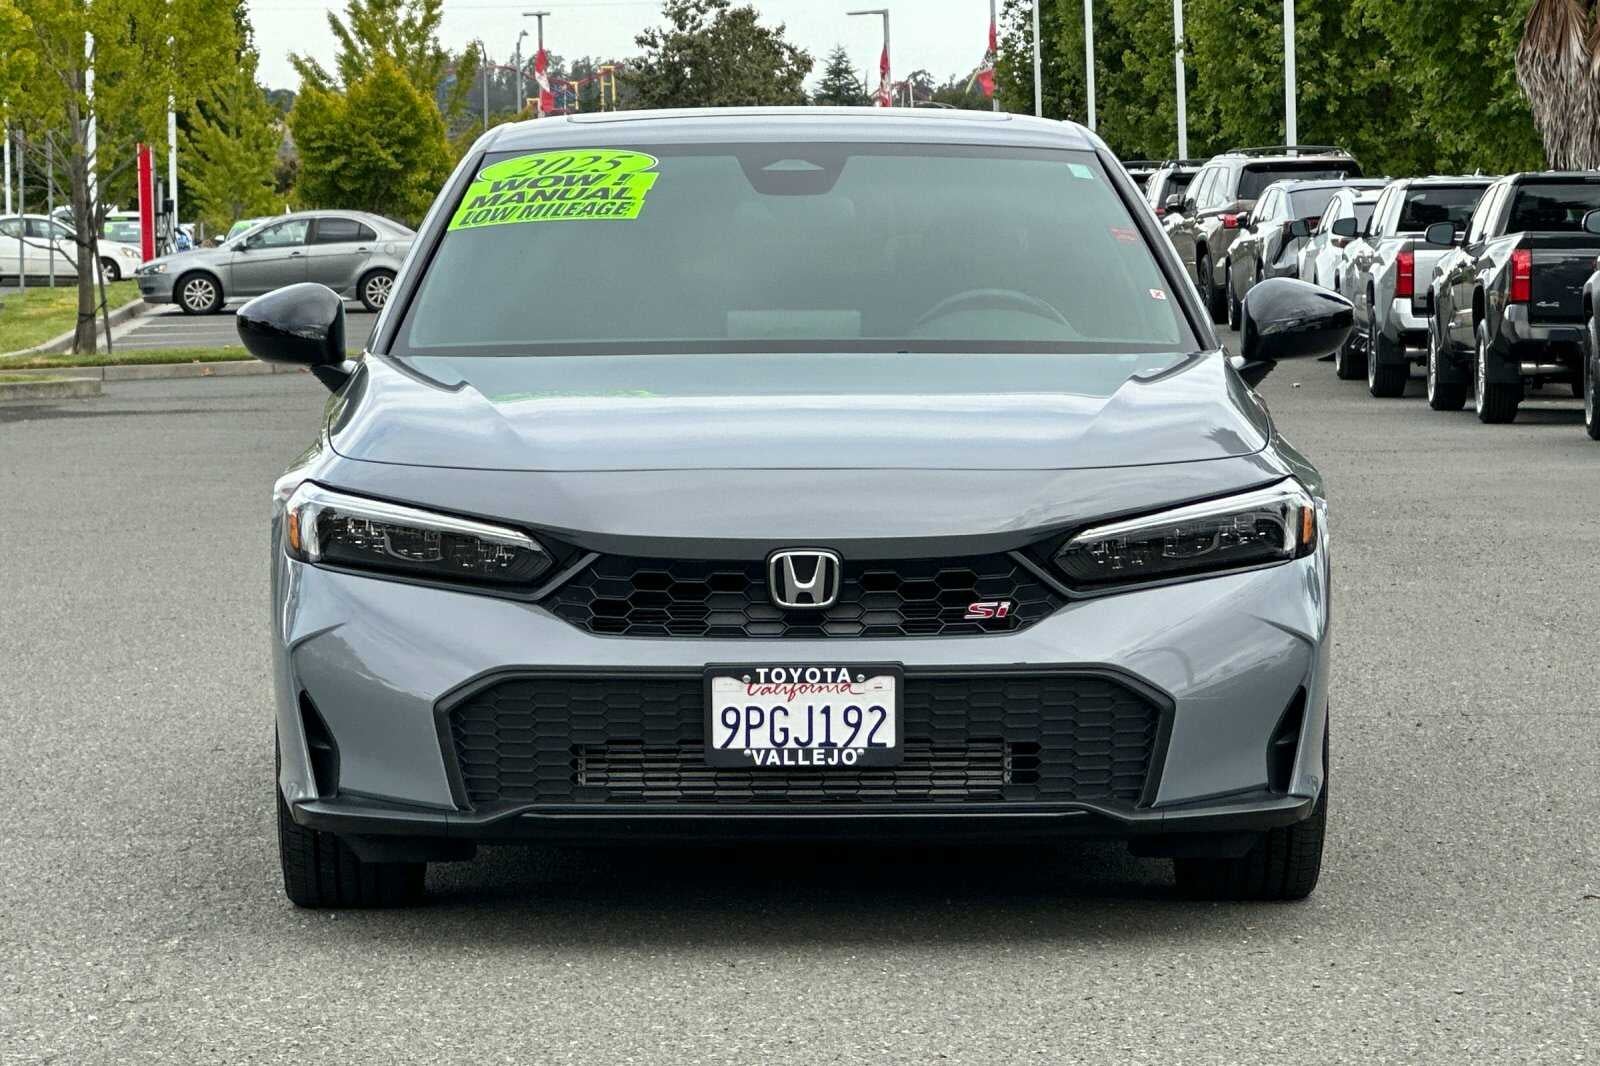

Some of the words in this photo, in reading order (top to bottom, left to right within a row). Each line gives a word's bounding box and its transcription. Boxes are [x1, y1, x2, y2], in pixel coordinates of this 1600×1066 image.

[510, 155, 634, 178] 2025
[467, 187, 634, 209] MANUAL
[459, 206, 517, 226] LOW
[516, 201, 633, 219] MILEAGE
[756, 668, 851, 684] TOYOTA
[747, 683, 865, 702] California
[720, 705, 887, 749] 9PGJ192
[752, 749, 857, 766] VALLEJO
